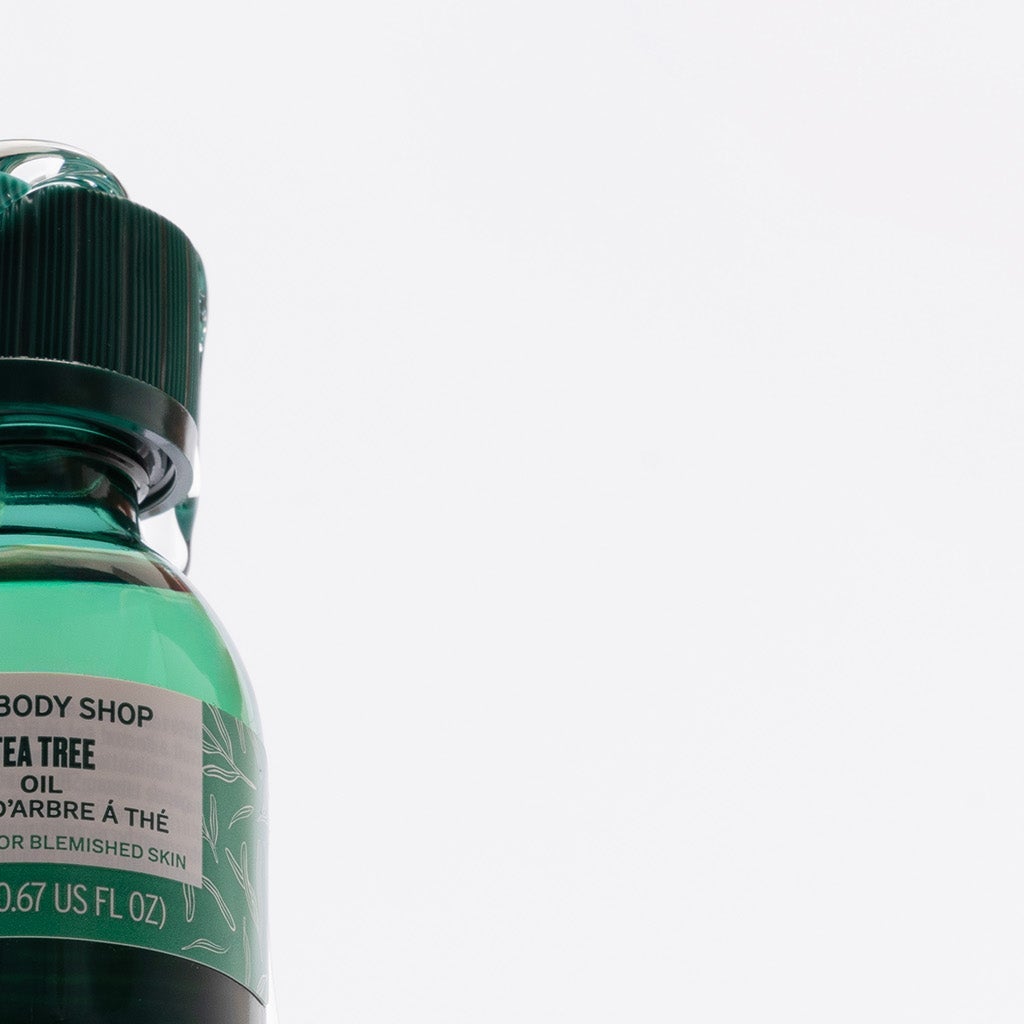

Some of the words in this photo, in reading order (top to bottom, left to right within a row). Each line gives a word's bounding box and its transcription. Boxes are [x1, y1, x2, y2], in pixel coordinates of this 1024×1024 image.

[79, 697, 153, 727] SHOP
[38, 736, 95, 770] TREE
[21, 775, 63, 793] OIL
[124, 807, 169, 833] THÉ
[30, 835, 143, 859] BLEMISHED
[148, 847, 186, 870] SKIN
[54, 883, 87, 914] US
[96, 886, 123, 919] FL
[129, 891, 166, 929] OZ)
